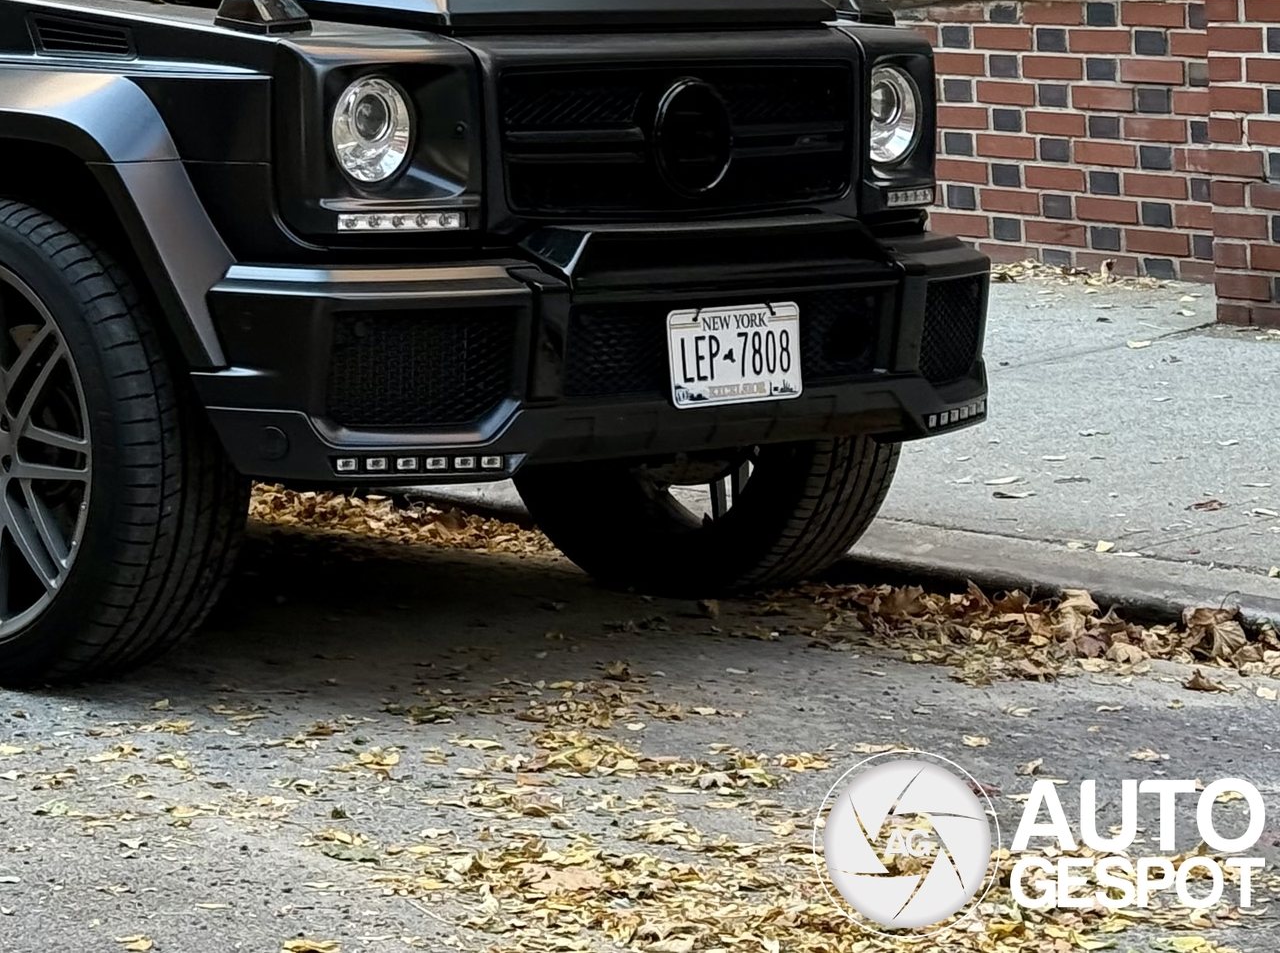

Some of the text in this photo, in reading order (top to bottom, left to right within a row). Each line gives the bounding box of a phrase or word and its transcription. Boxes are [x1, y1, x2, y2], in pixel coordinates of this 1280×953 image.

[702, 312, 767, 331] NEW YORK
[680, 329, 791, 383] LEP 7808
